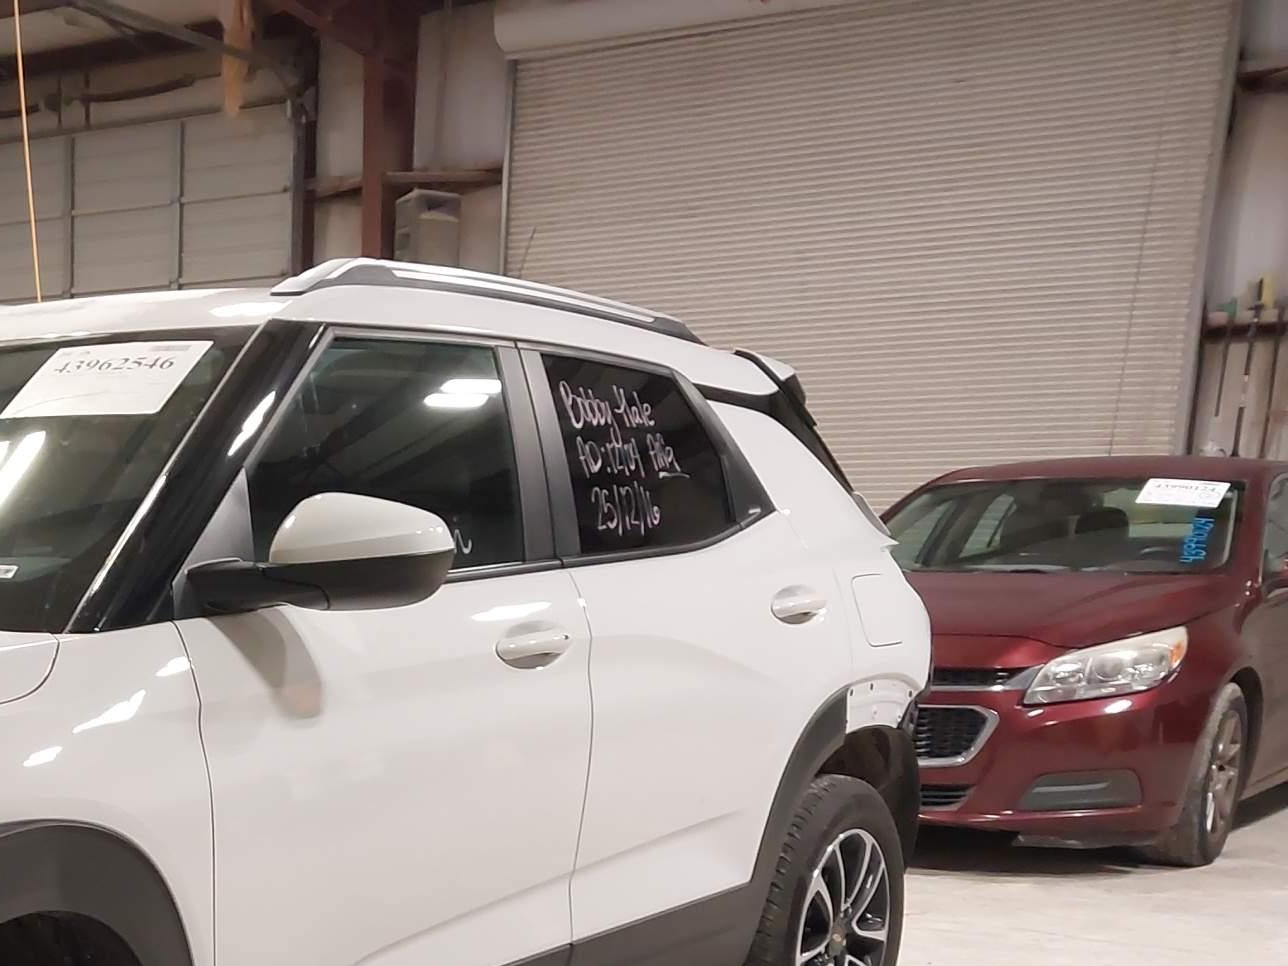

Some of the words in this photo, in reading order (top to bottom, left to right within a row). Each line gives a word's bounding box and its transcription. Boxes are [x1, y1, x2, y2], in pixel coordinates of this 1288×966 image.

[54, 355, 176, 374] 43962546
[559, 380, 622, 447] Bobby
[591, 480, 661, 537] 25/12/16
